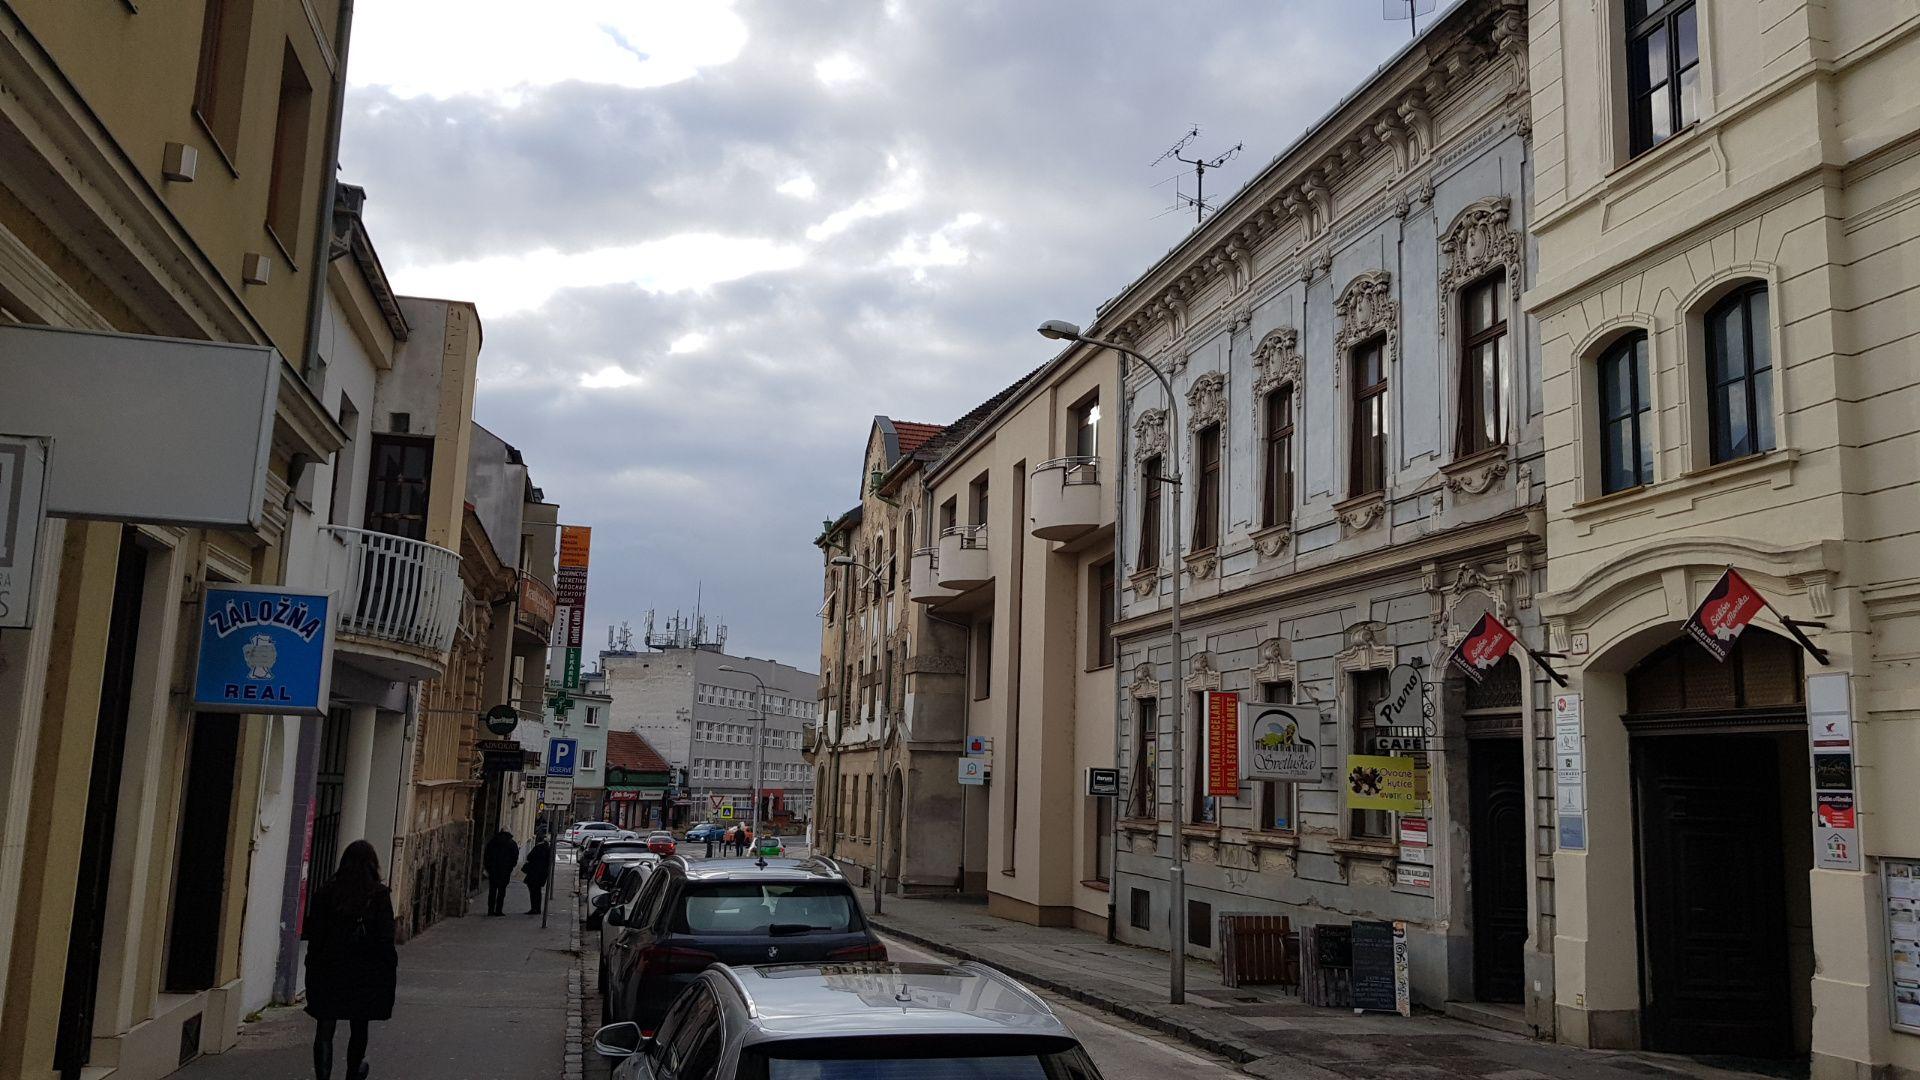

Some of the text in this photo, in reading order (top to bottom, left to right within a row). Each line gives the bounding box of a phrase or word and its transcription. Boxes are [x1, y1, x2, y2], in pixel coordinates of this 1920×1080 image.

[208, 596, 321, 643] ZÁLOŽŇA
[1725, 594, 1750, 625] Monika
[1690, 620, 1727, 657] kaderníctvo
[224, 684, 291, 701] REAL
[1379, 671, 1418, 725] Piano
[556, 743, 569, 763] P
[1227, 696, 1237, 788] REAL ESTATE MARKET
